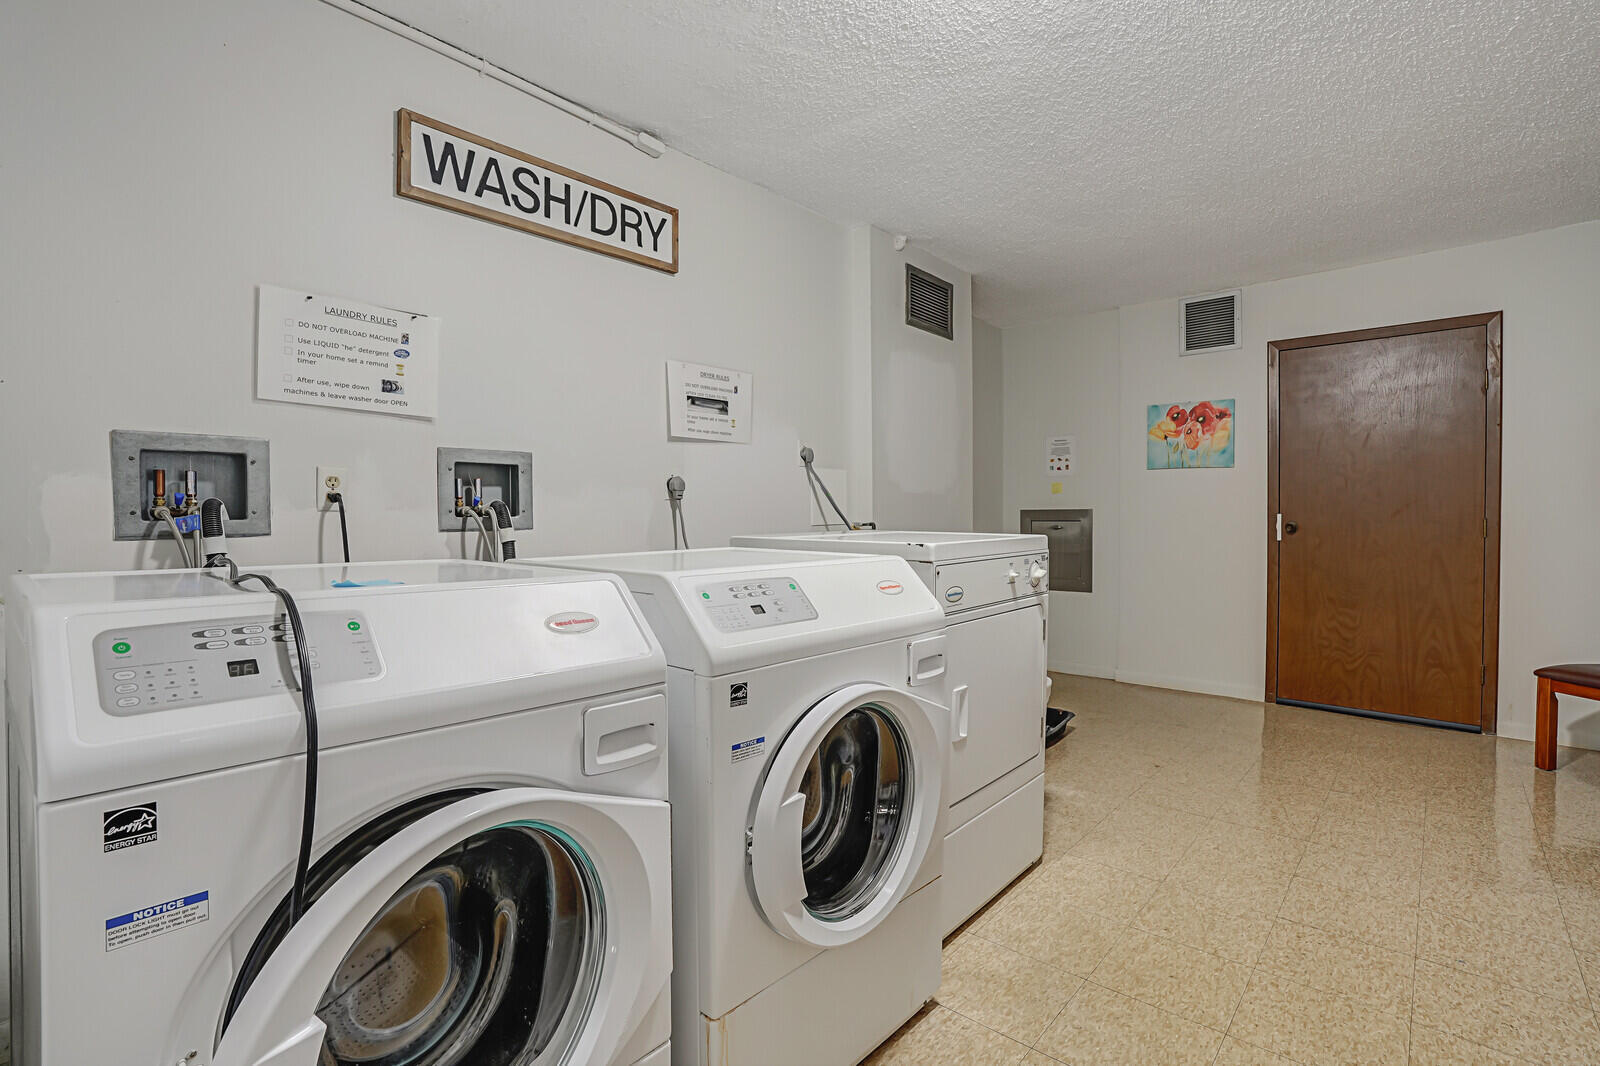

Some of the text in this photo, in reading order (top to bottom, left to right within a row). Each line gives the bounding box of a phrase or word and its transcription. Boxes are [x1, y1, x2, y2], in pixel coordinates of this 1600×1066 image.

[422, 133, 667, 252] WASH/DRY
[324, 306, 398, 326] LAUNDRY RULES
[330, 326, 367, 338] OVERLOAD
[369, 334, 398, 343] MACHINE
[314, 340, 339, 348] LIQUID
[358, 347, 389, 357] detergent
[326, 354, 345, 362] home
[366, 360, 388, 368] remind
[284, 388, 318, 396] machines
[328, 392, 346, 400] leave
[105, 833, 157, 852] ENERGY STAR
[133, 899, 184, 920] NOTICE
[108, 927, 127, 936] DOOR
[148, 916, 165, 924] LIGHT
